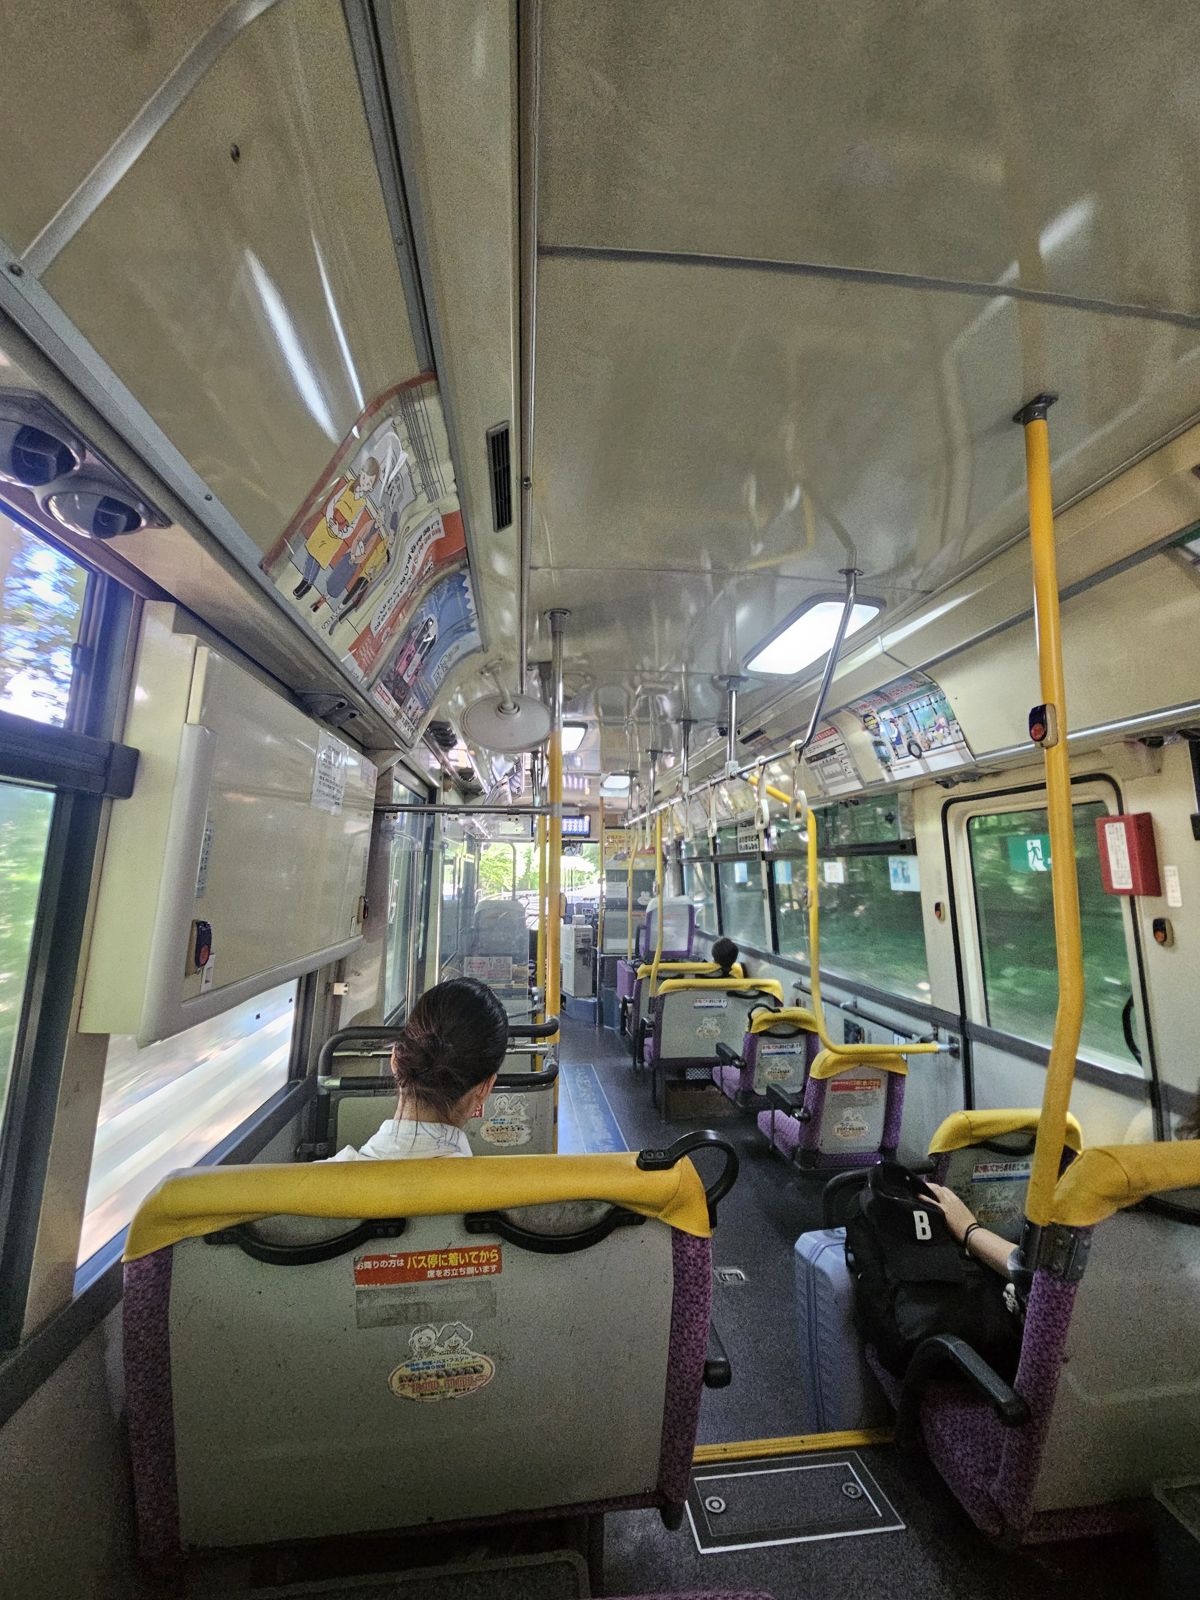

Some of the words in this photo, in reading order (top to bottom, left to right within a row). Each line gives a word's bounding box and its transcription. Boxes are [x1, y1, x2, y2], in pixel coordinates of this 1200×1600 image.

[913, 1210, 932, 1240] B
[407, 1249, 499, 1269] バス停に着いてから
